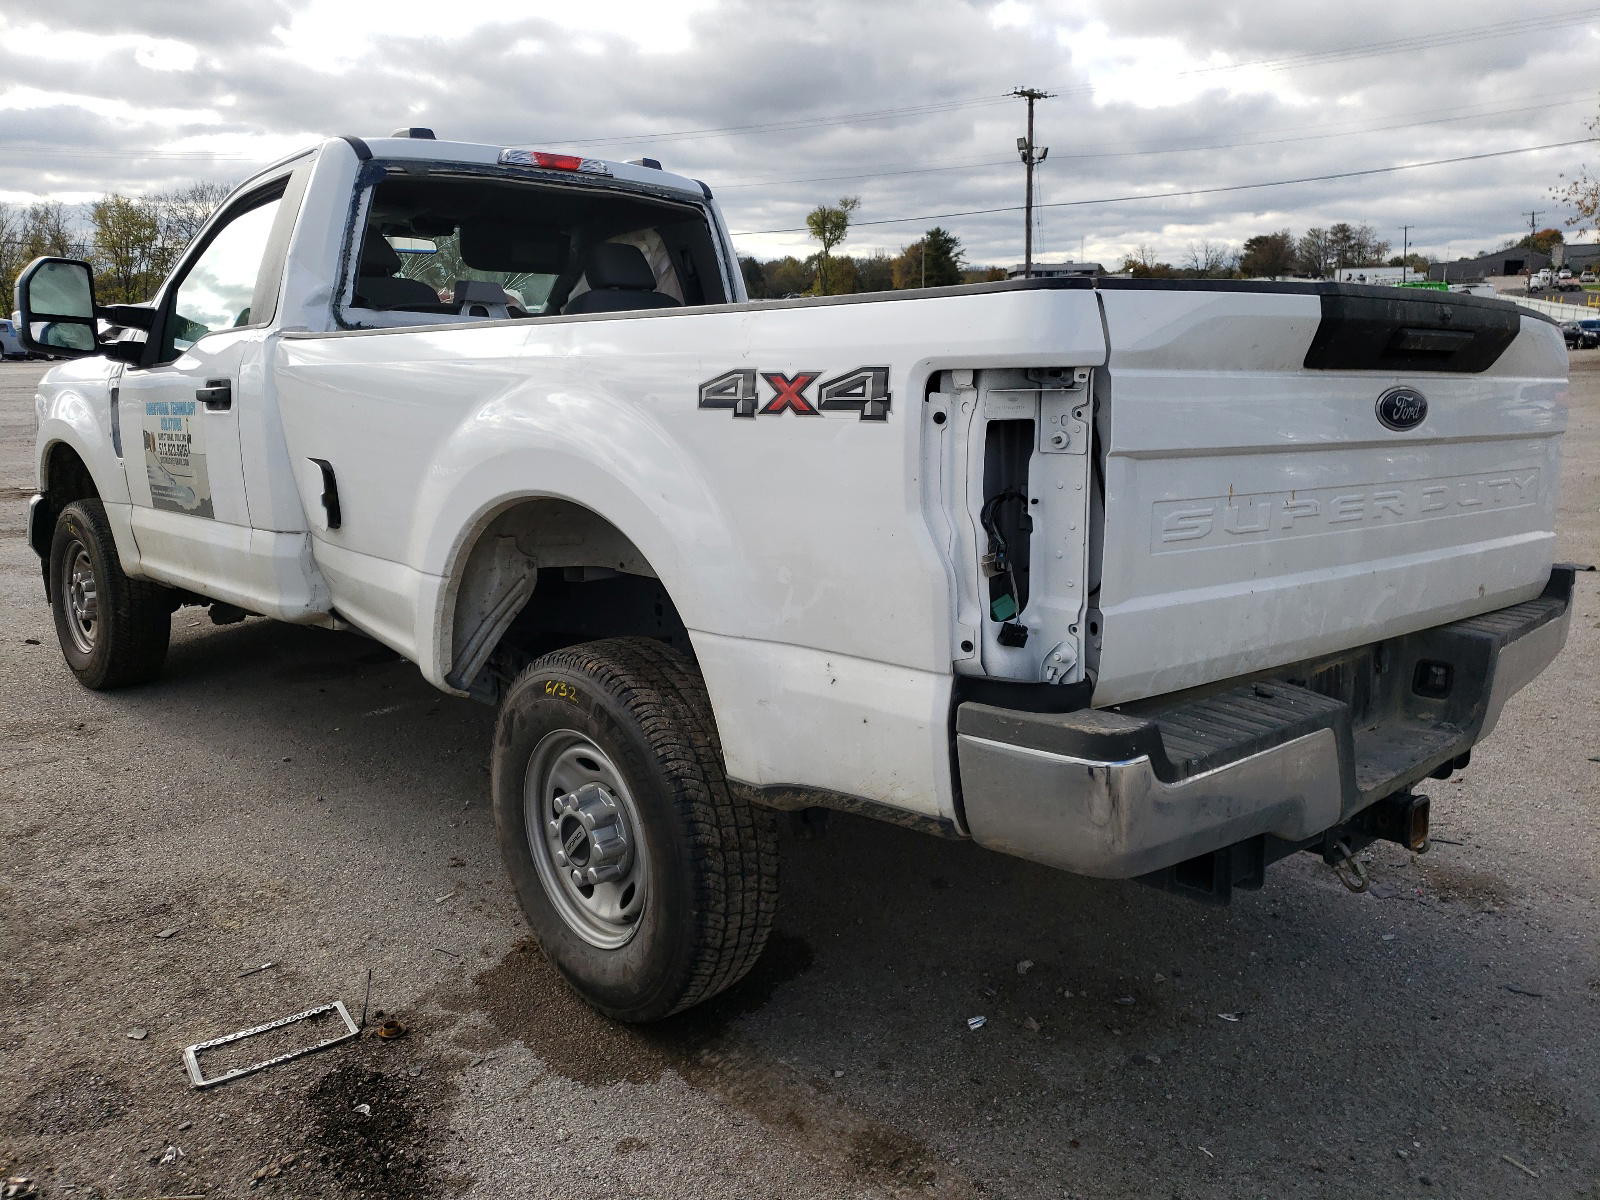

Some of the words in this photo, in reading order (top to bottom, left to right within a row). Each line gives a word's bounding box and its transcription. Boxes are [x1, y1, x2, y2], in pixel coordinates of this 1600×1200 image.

[1393, 396, 1421, 420] Ford
[1162, 490, 1404, 543] SUPER
[1421, 474, 1536, 513] DUTY
